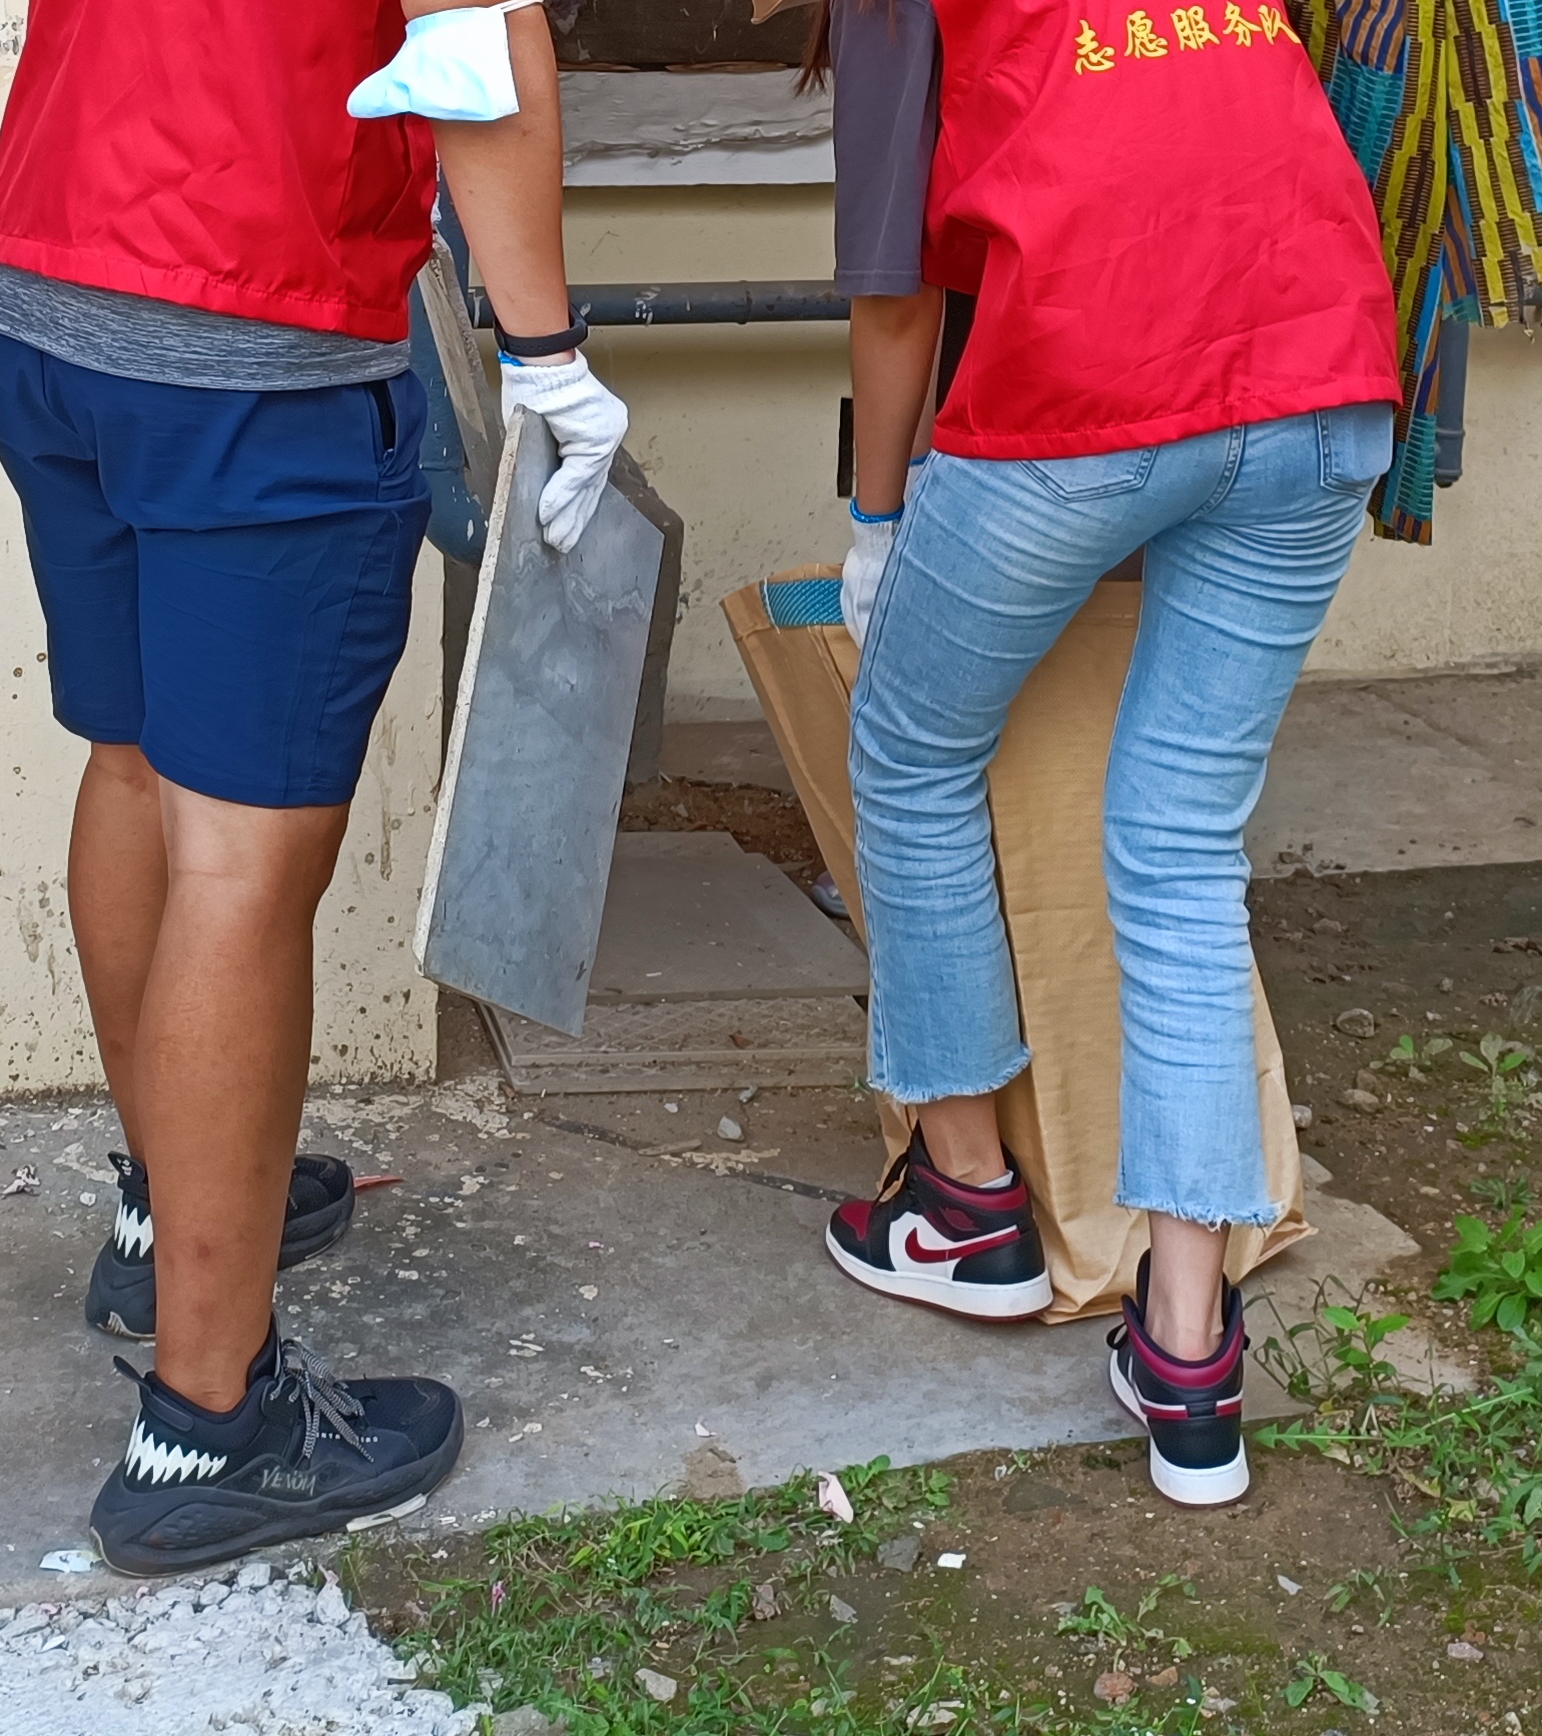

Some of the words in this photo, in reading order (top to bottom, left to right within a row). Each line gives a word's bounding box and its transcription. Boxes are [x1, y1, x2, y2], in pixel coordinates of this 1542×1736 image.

[1074, 0, 1302, 76] 志愿服务队
